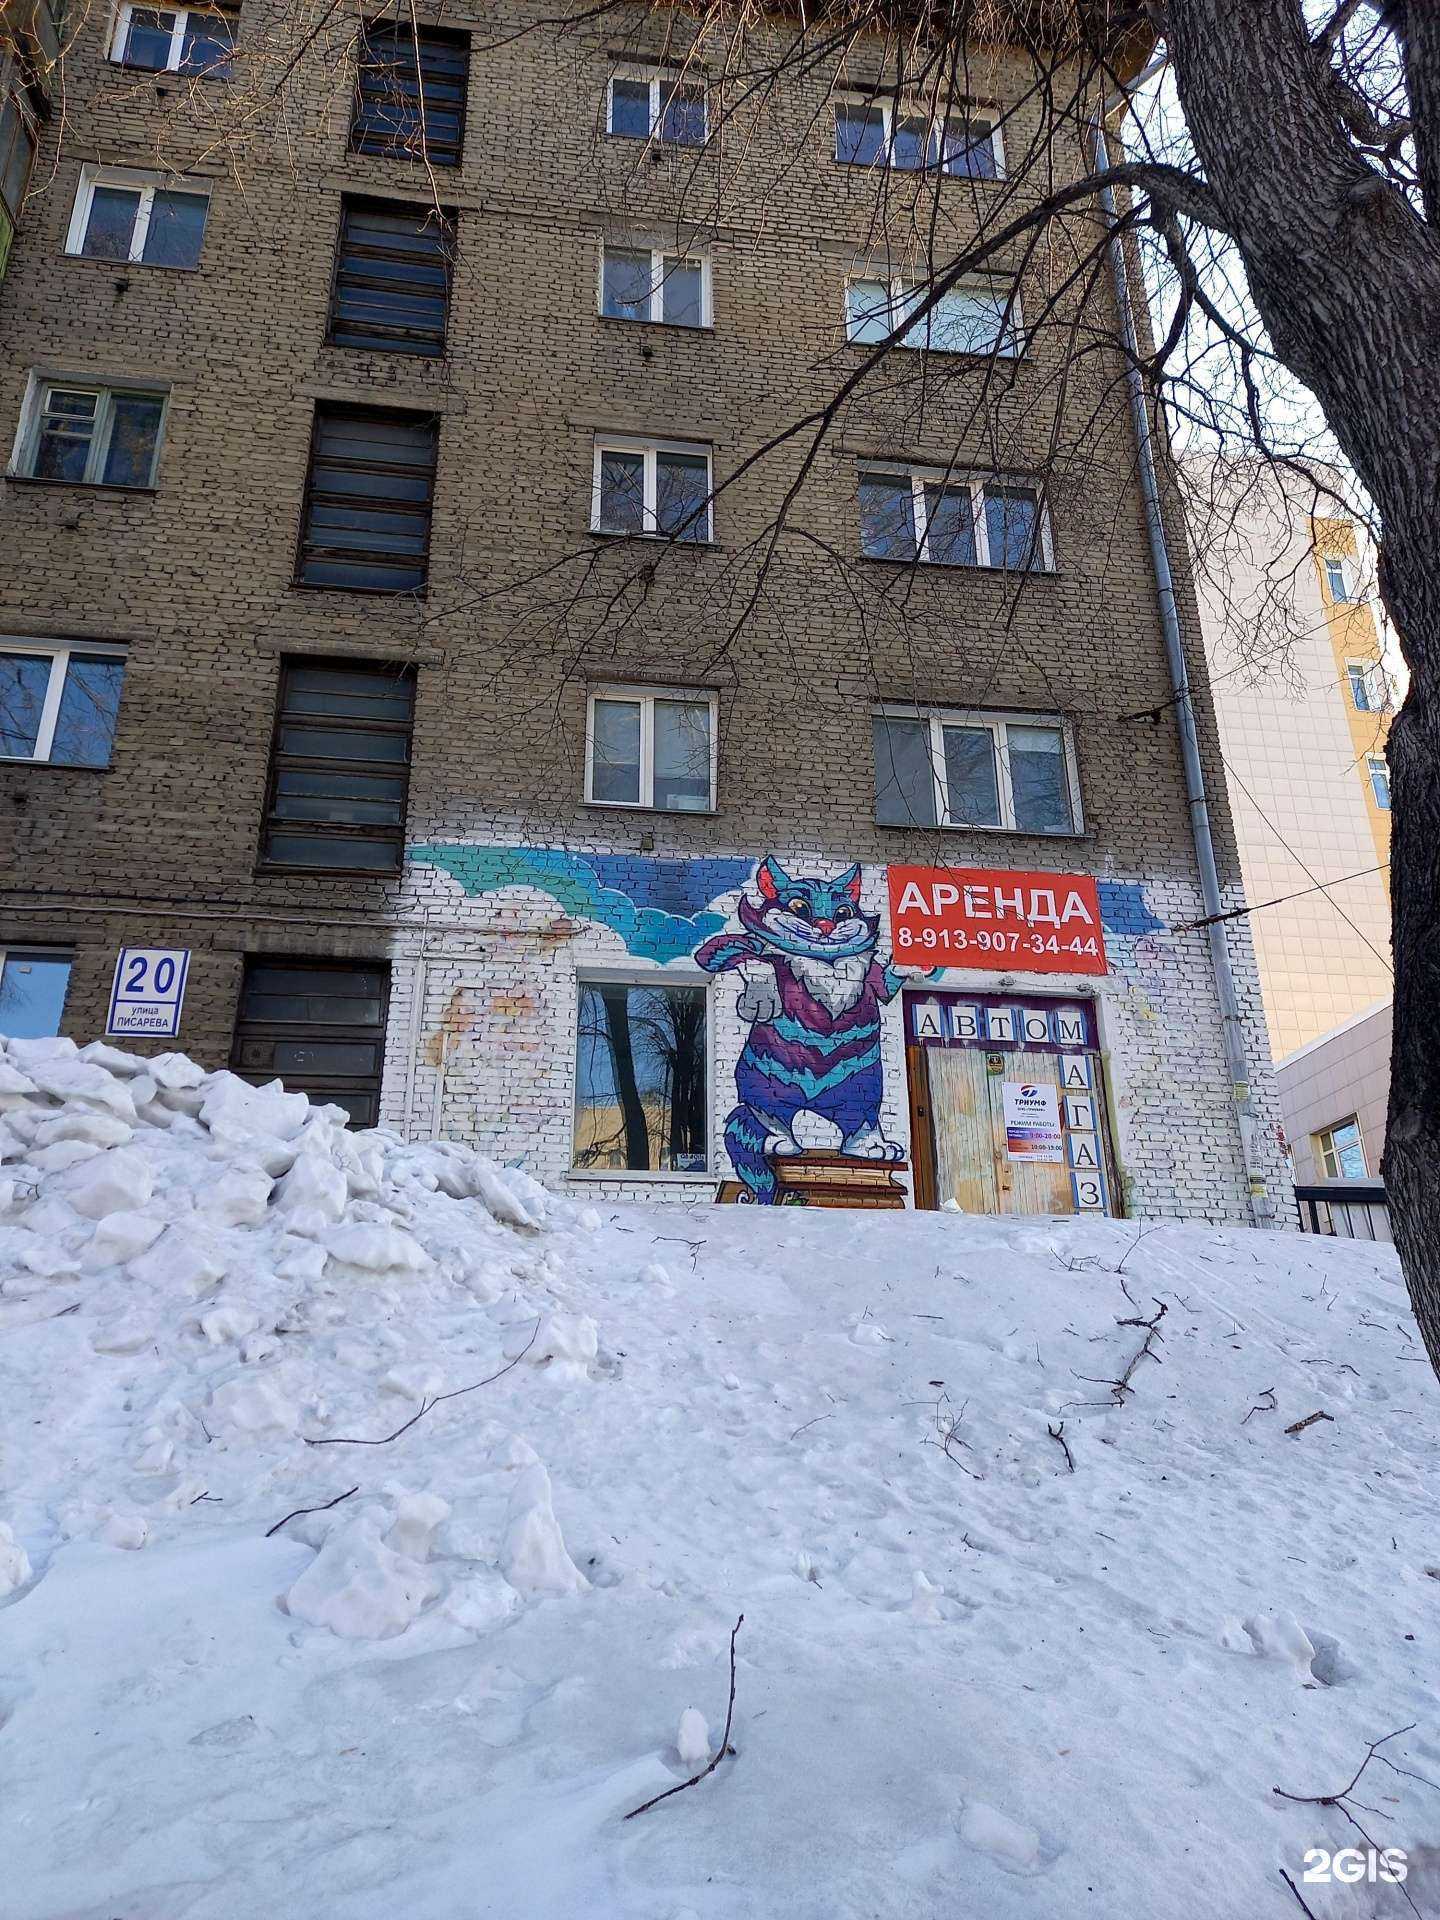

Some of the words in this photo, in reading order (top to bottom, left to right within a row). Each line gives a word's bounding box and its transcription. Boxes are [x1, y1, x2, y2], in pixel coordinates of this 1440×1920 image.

[897, 882, 1094, 929] АРЕНДА
[898, 927, 1099, 956] 8-913-907-34-44
[125, 957, 175, 994] 20
[117, 1017, 168, 1027] ПИСАРЕВА
[131, 1007, 159, 1016] улица
[919, 1014, 1082, 1039] АВТОМ
[1014, 1098, 1047, 1106] ТРИУМФ
